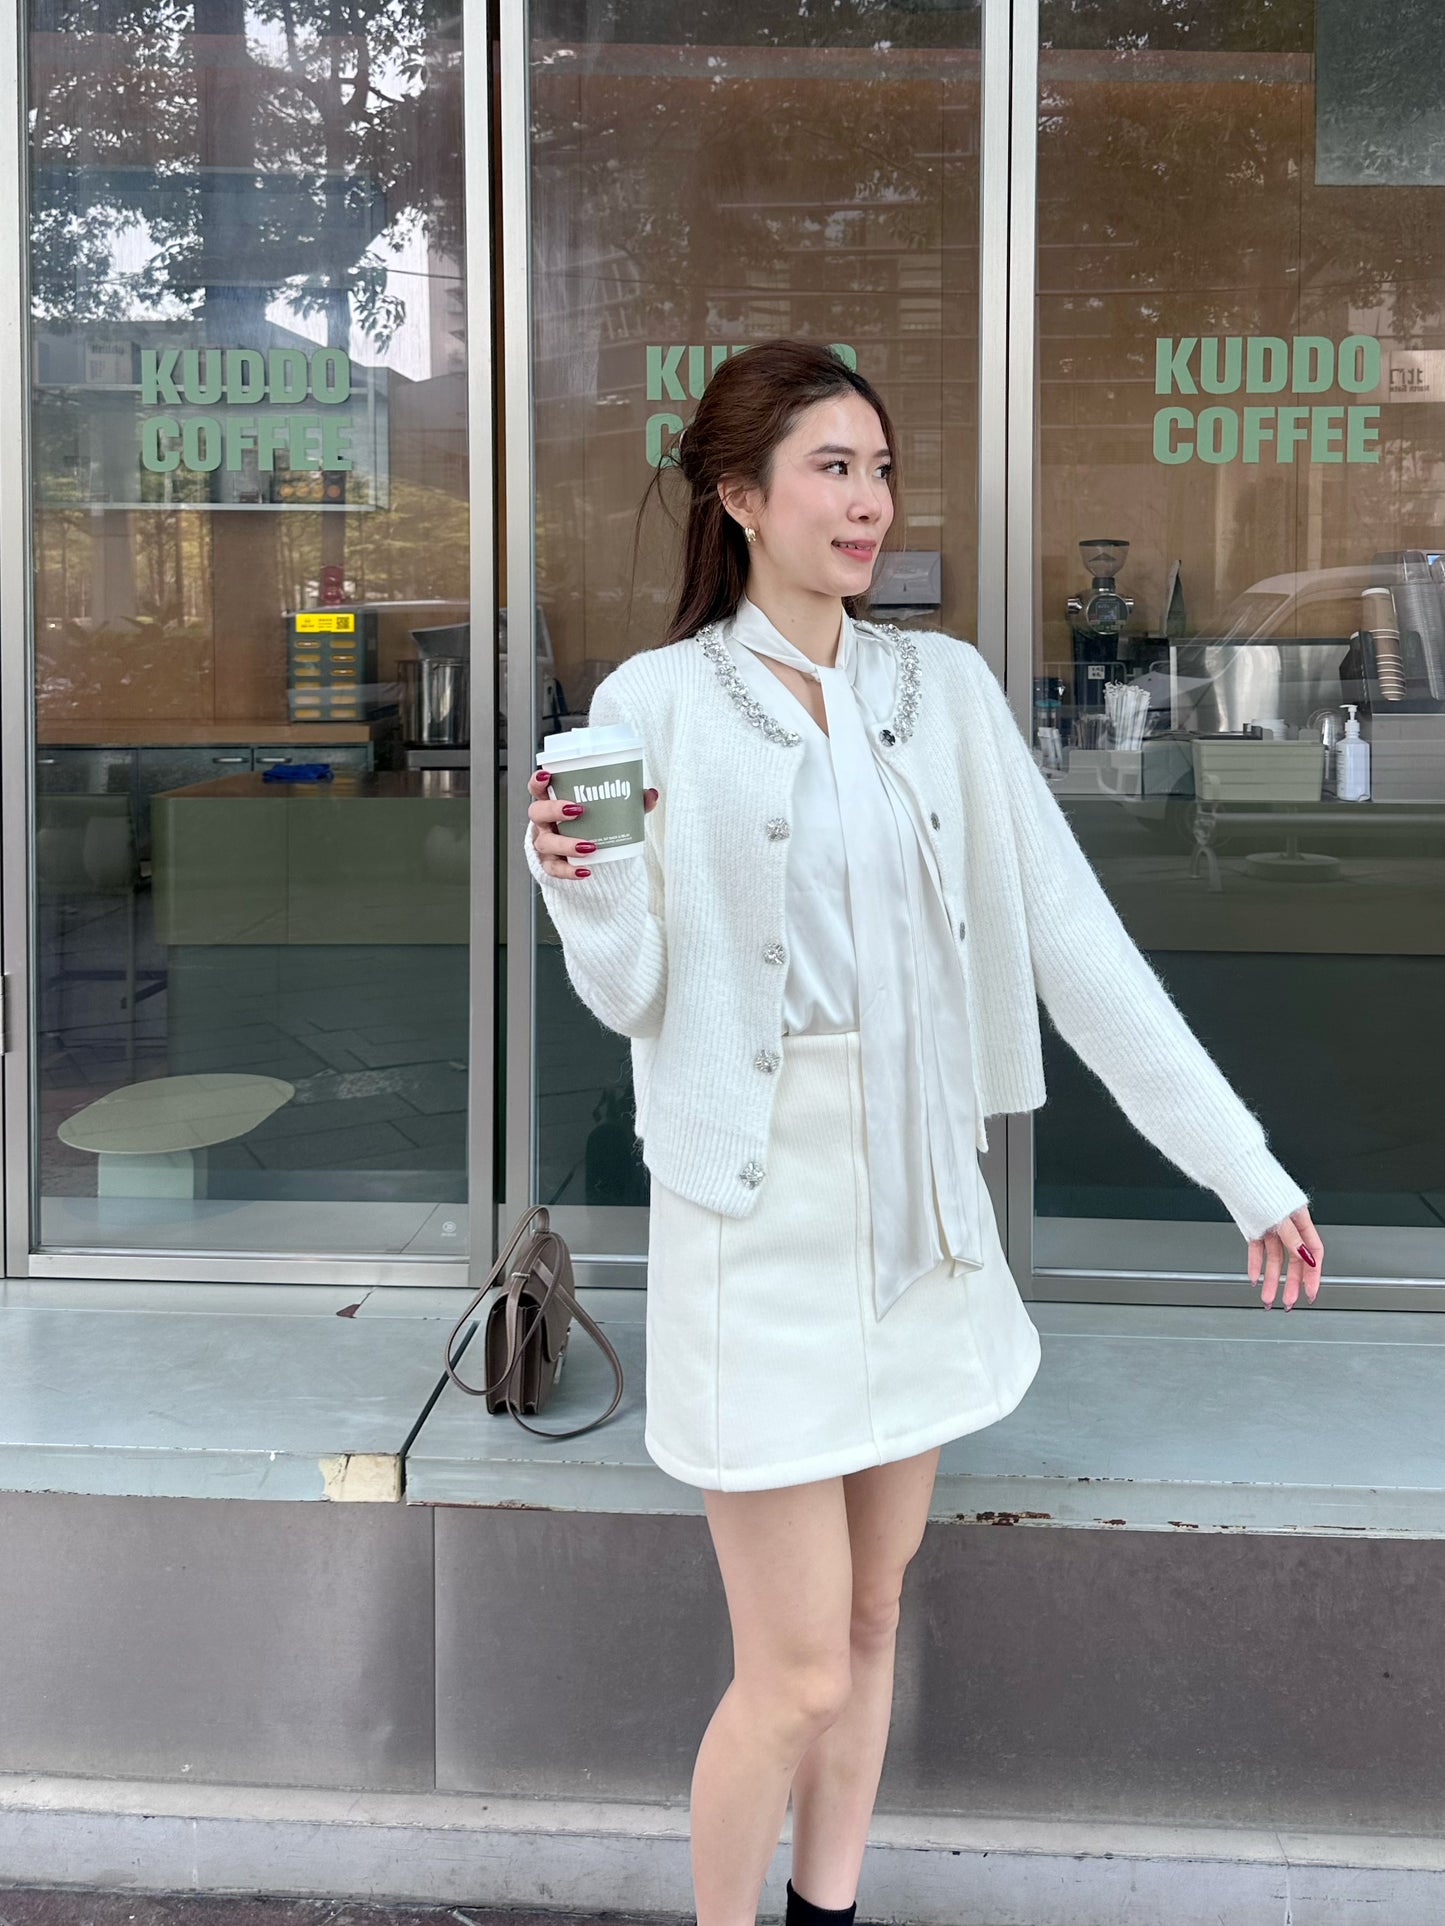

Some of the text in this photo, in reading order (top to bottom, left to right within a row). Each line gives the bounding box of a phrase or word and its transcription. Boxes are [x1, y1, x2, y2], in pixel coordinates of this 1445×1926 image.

[141, 347, 351, 405] KUDDO
[1154, 334, 1381, 395] KUDDO
[142, 415, 353, 473] COFFEE
[1152, 405, 1381, 465] COFFEE
